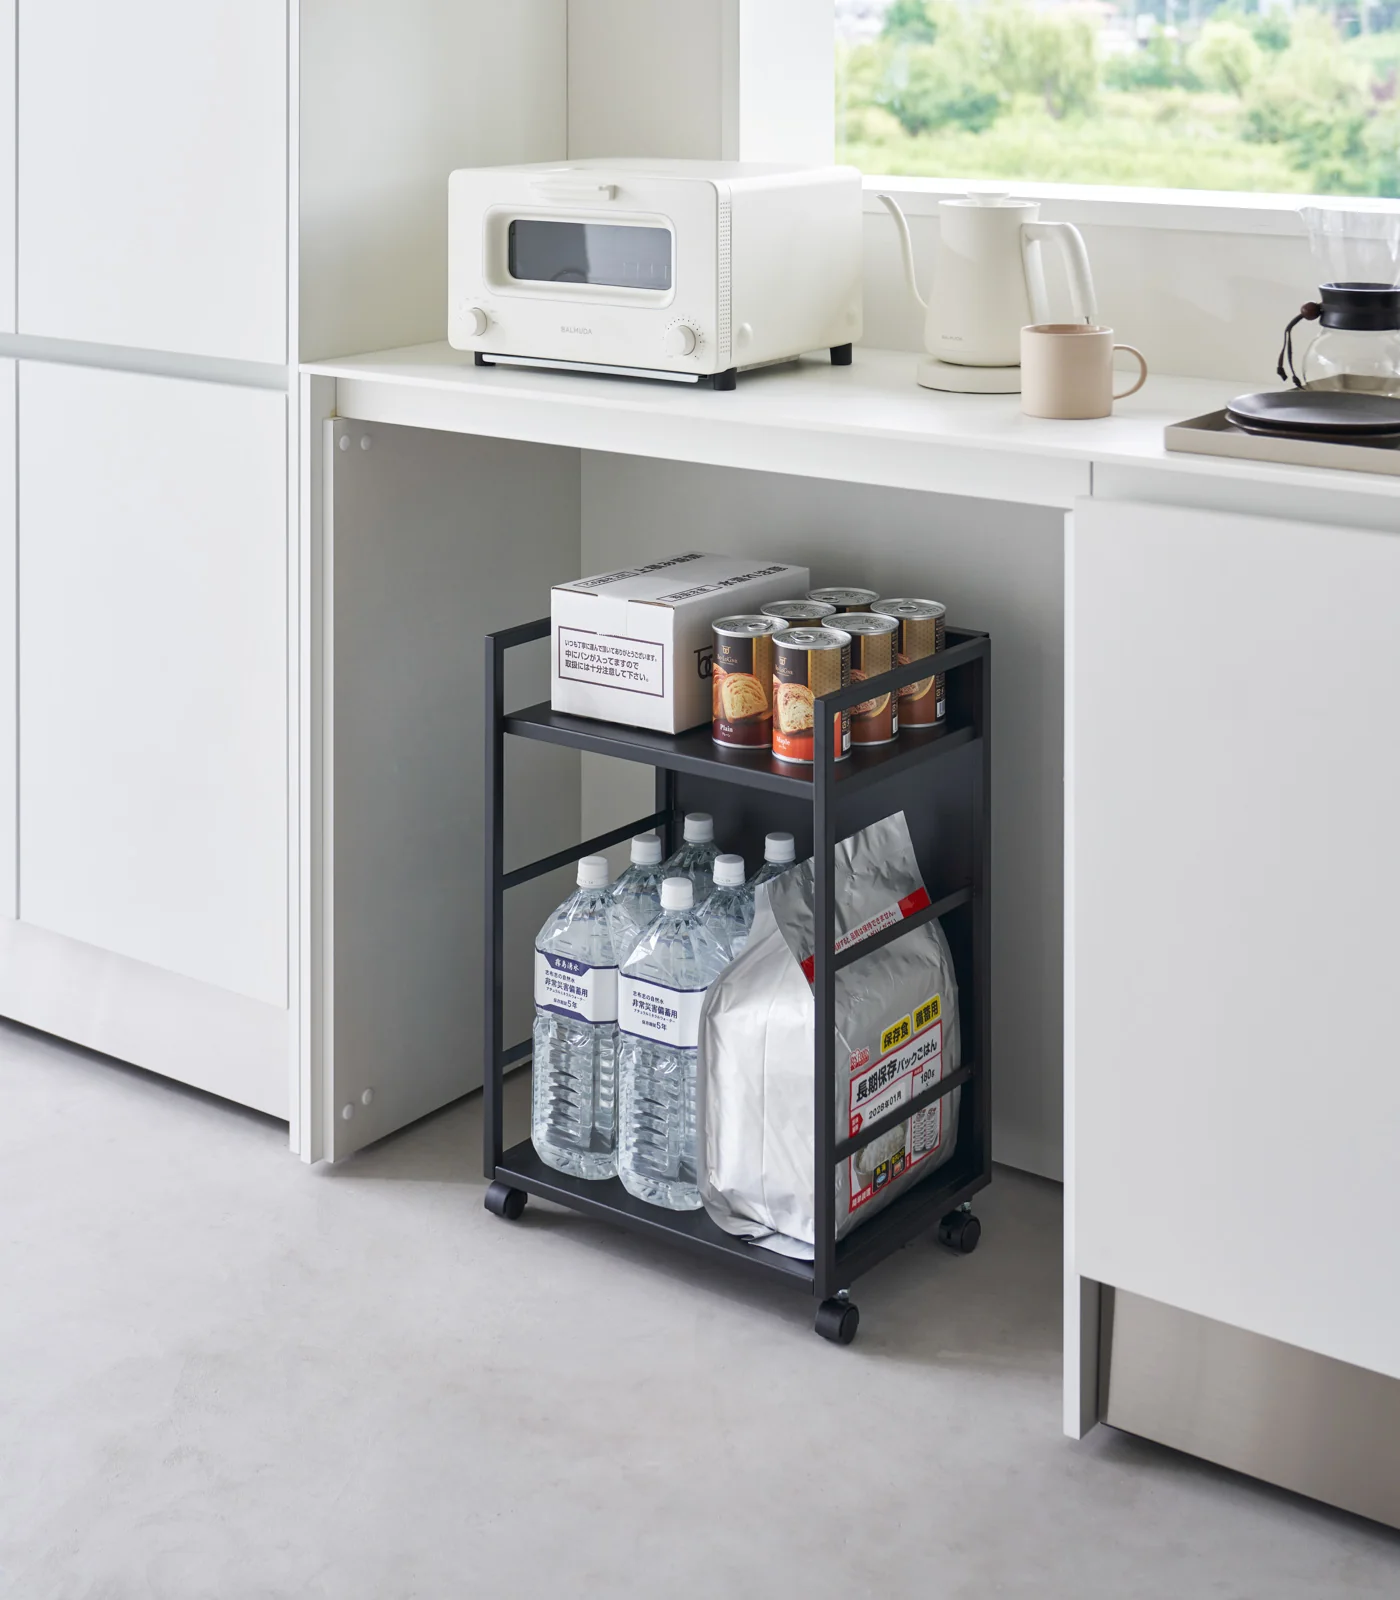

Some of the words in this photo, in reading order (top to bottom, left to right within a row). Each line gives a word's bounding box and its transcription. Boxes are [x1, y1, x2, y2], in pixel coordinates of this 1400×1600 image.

[565, 660, 649, 682] 取扱には十分注意して下さい。
[720, 724, 733, 733] Plain
[545, 977, 588, 998] 非常災害備蓄用
[632, 999, 678, 1019] 非常災害備蓄用
[915, 1000, 939, 1028] 備蓄用
[883, 1021, 909, 1049] 保存食
[868, 1090, 902, 1119] 2028年01月
